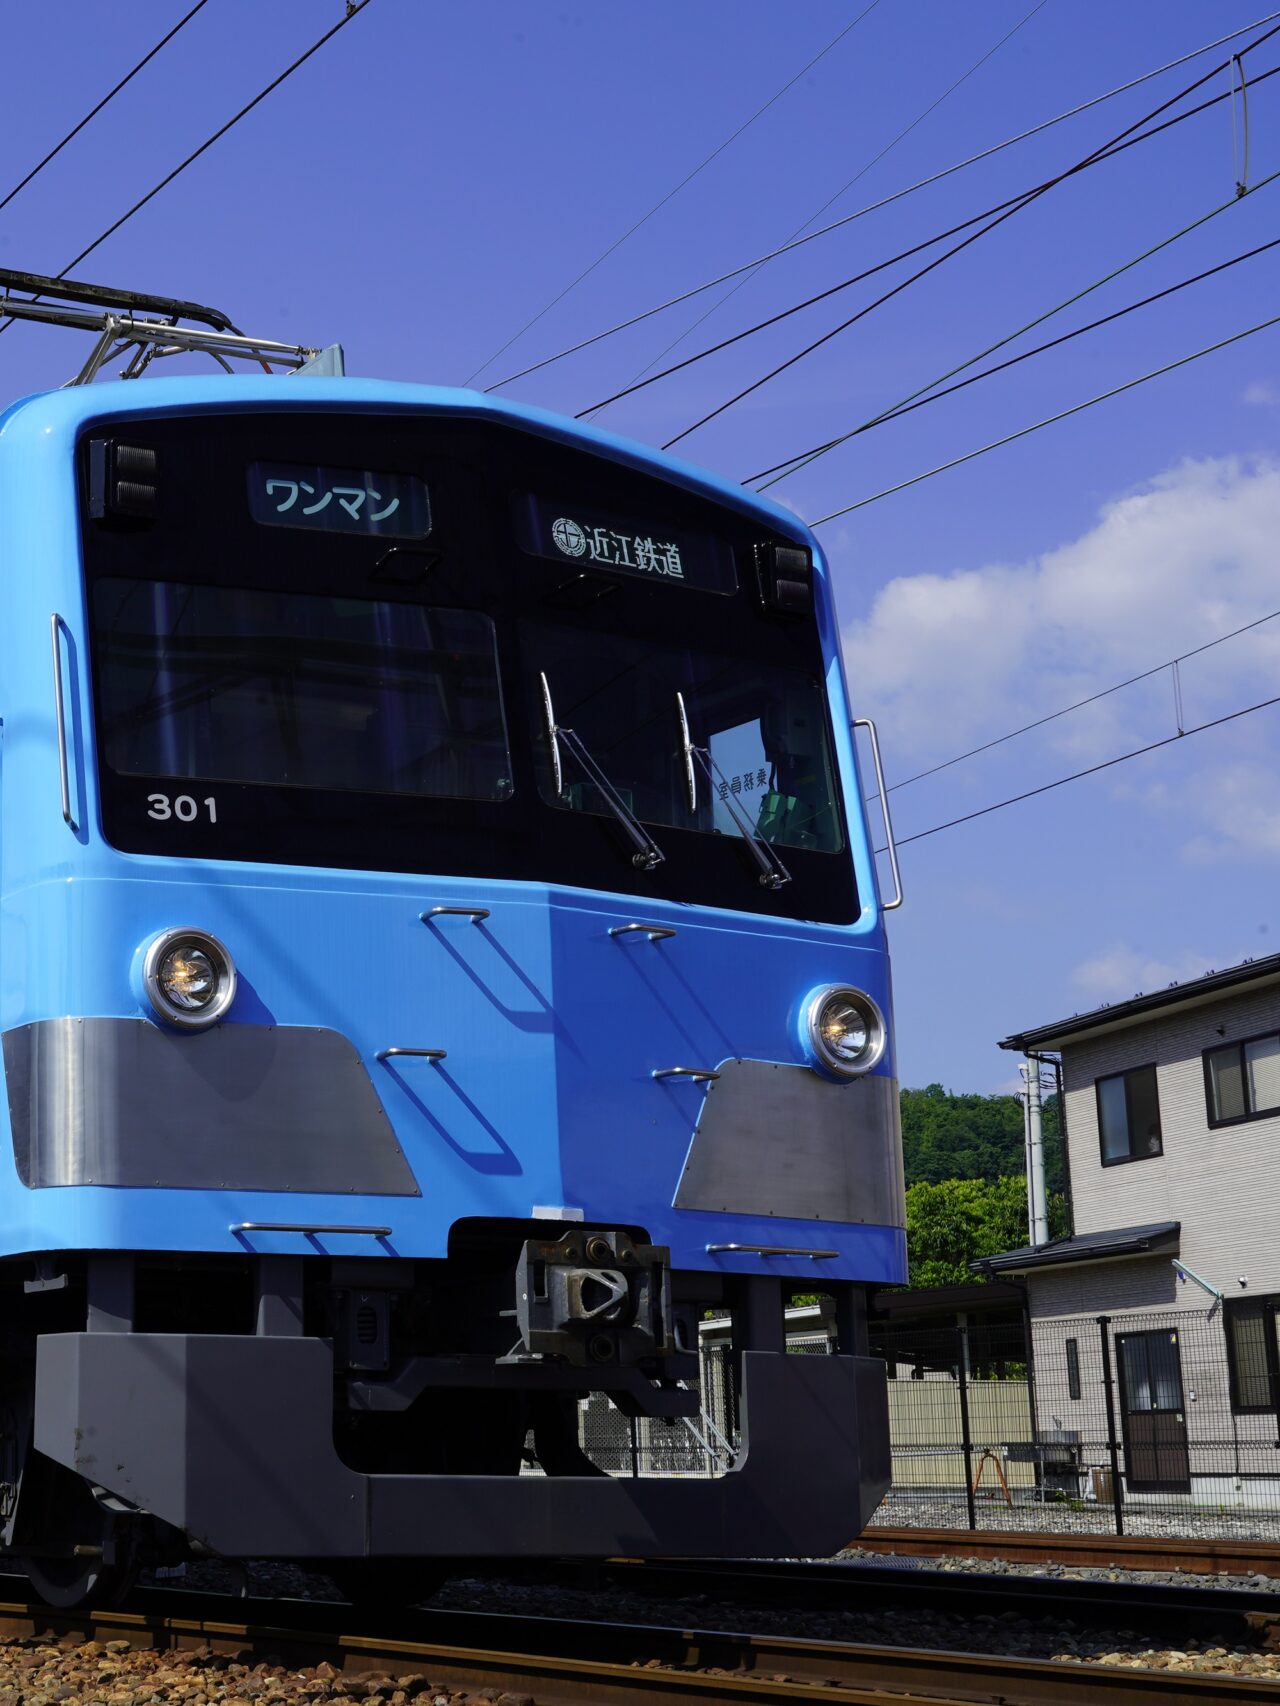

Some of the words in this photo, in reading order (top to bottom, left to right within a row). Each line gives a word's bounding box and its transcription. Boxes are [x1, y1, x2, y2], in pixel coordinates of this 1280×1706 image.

[266, 479, 400, 522] ワンマン
[584, 525, 685, 579] 近江鉄道
[147, 793, 217, 824] 301
